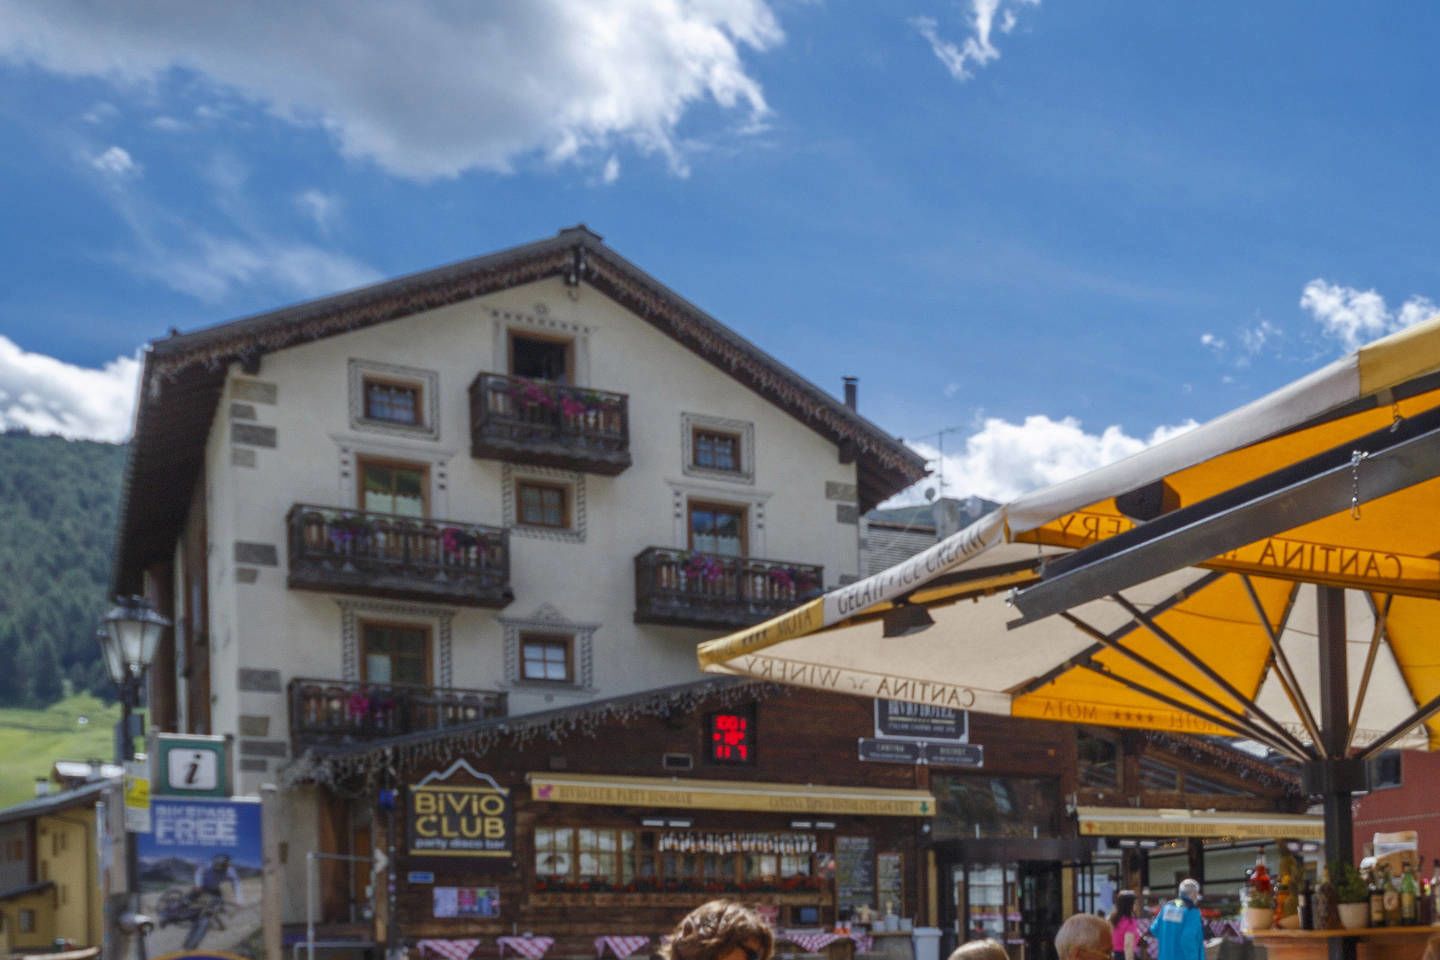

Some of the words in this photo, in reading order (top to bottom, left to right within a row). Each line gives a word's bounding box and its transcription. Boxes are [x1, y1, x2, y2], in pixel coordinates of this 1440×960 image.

[838, 576, 884, 614] GELATI
[155, 818, 238, 842] FREE
[415, 816, 506, 839] CLUB
[415, 838, 447, 850] party
[450, 839, 483, 849] disco
